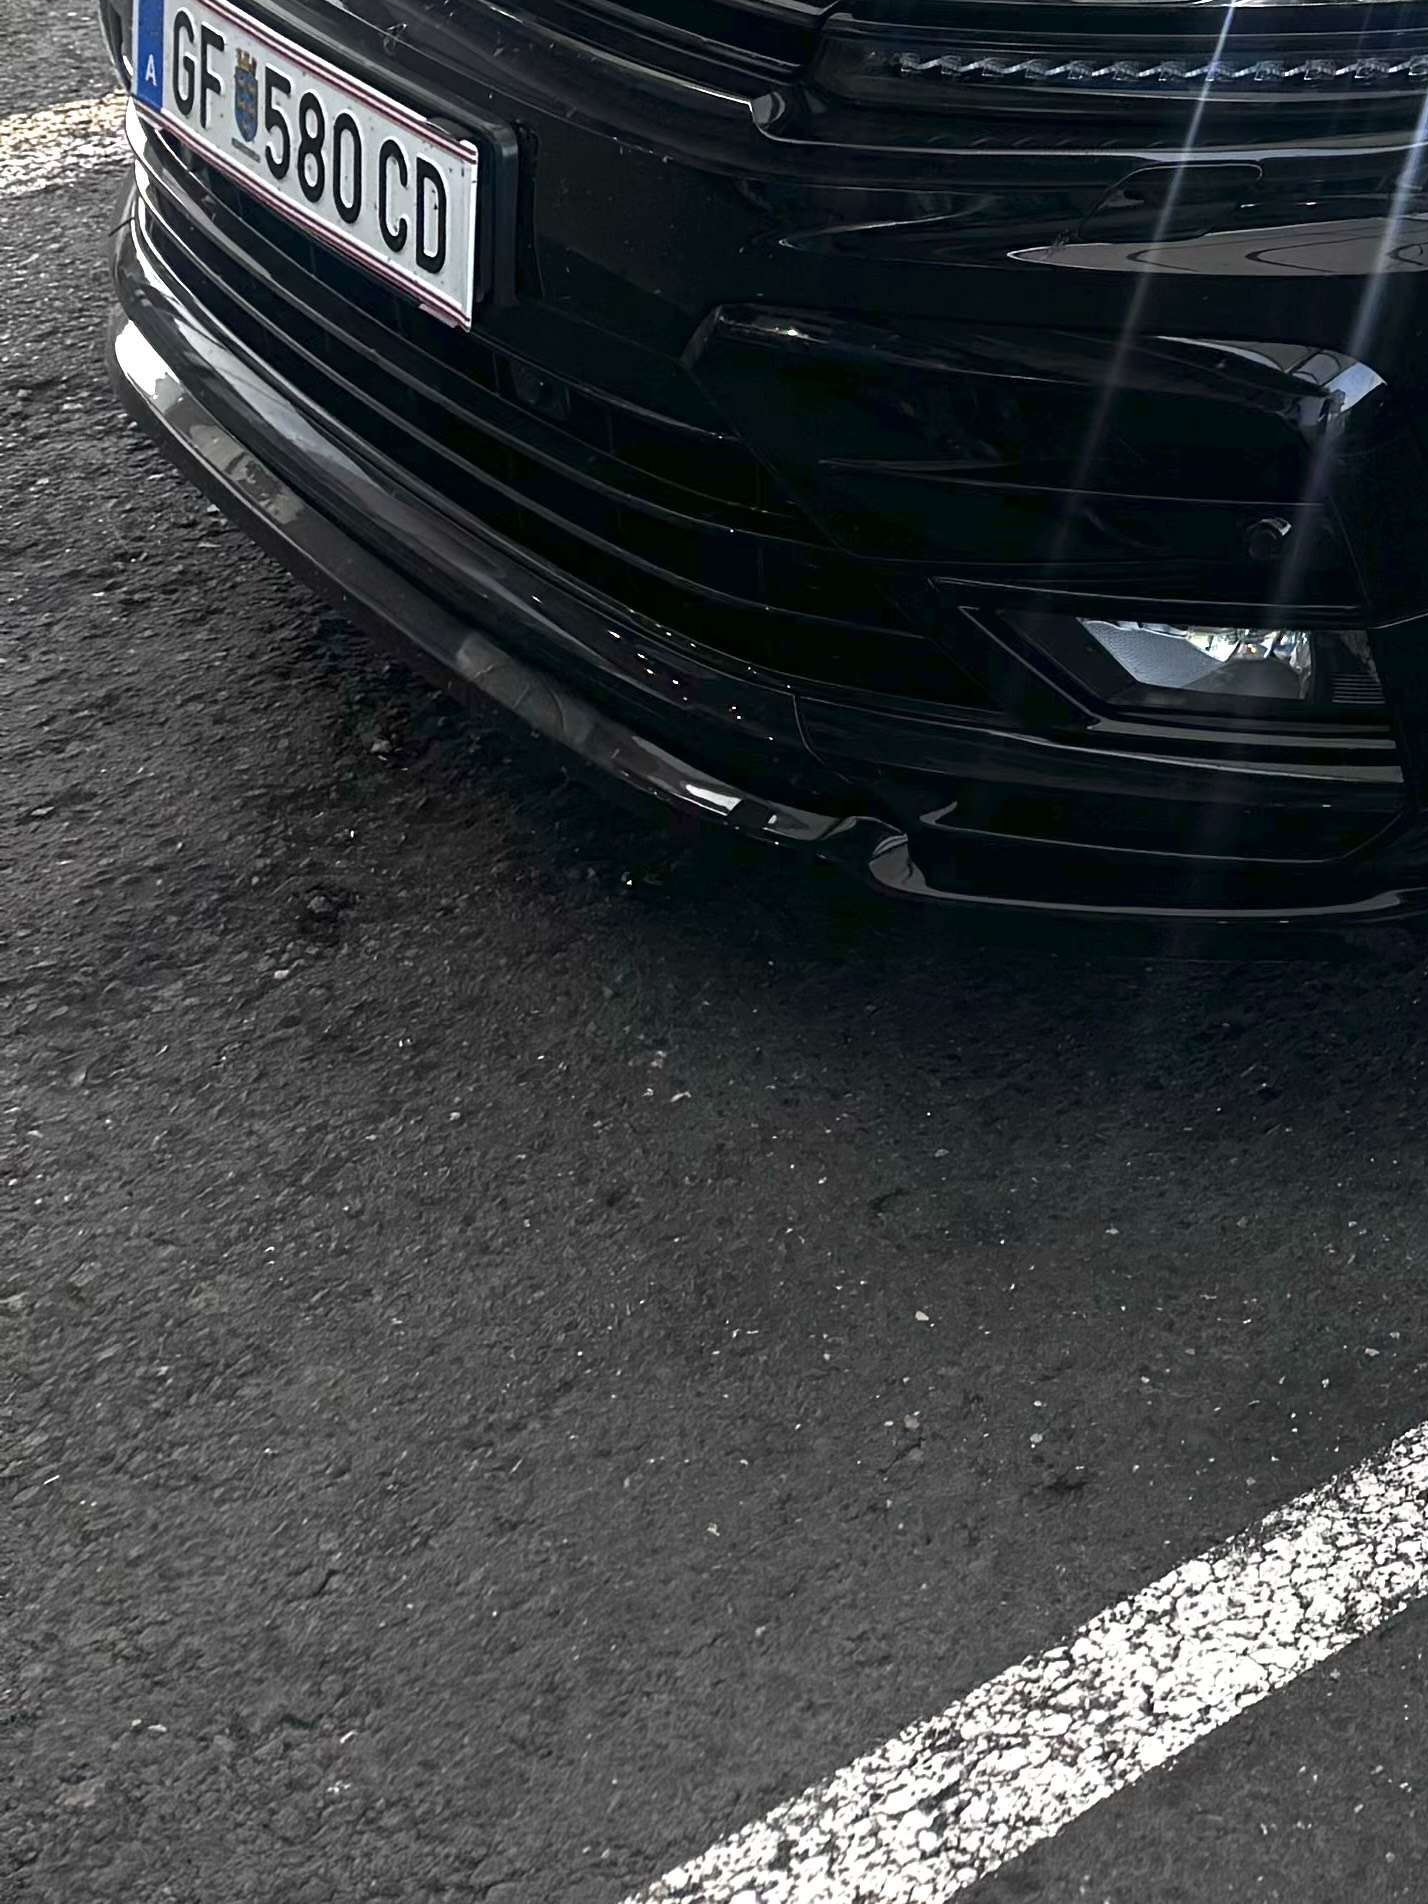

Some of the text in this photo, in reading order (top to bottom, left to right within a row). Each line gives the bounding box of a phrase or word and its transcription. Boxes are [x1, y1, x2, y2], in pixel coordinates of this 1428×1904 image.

[144, 53, 157, 87] A
[172, 9, 447, 274] GF 580 CD
